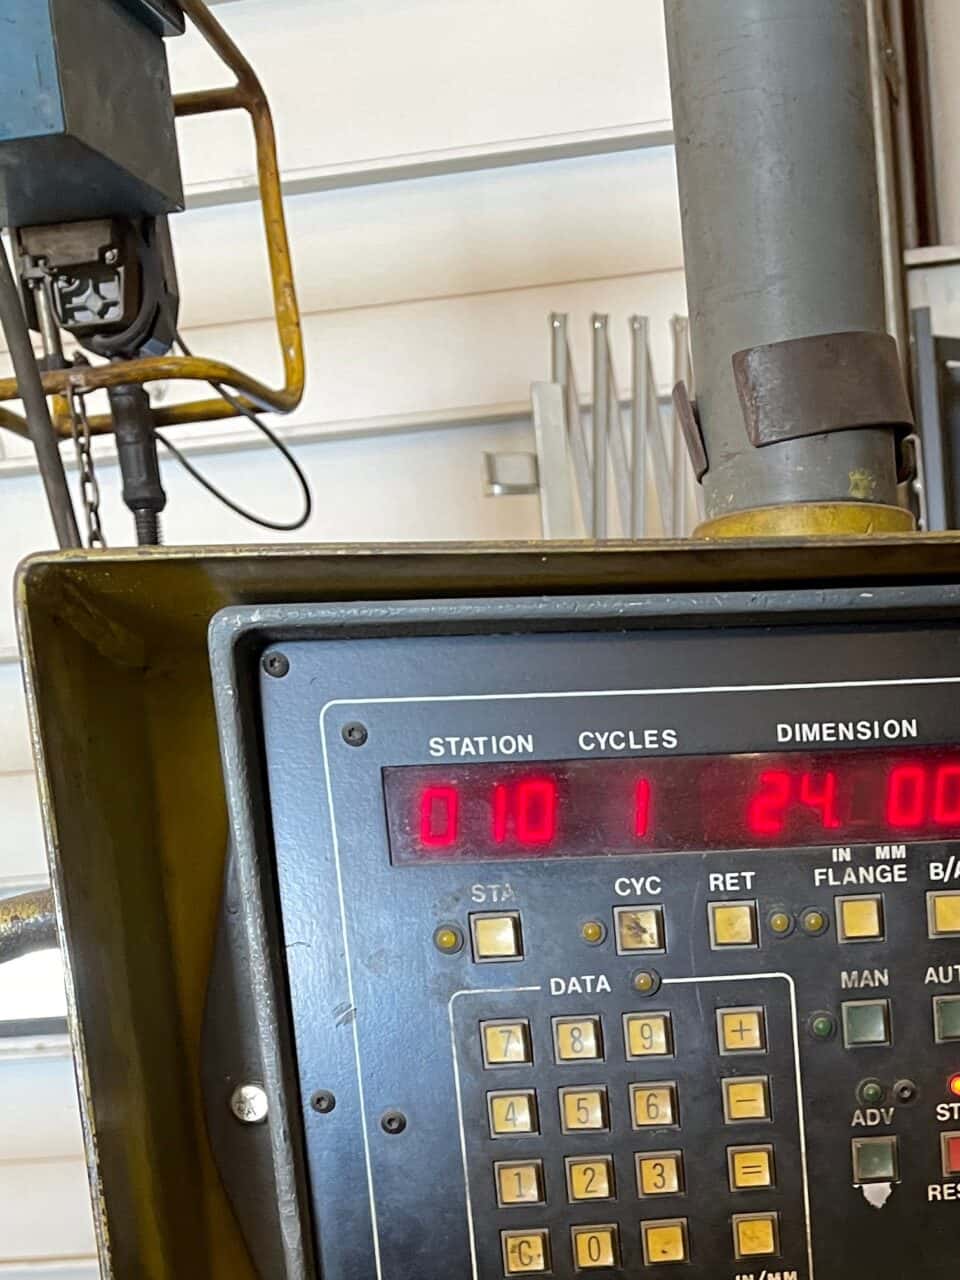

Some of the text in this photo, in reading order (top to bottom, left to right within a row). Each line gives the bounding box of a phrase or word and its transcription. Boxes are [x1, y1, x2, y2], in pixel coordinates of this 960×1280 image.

[578, 729, 678, 752] CYCLES
[776, 719, 919, 743] DIMENSION
[429, 734, 534, 757] STATION
[832, 845, 906, 862] IN MM
[614, 876, 662, 896] CYC
[709, 872, 755, 891] RET
[814, 864, 908, 887] FLANGE
[471, 883, 516, 903] STA
[550, 975, 611, 996] DATA
[841, 969, 889, 989] MAN
[498, 1029, 514, 1057] 7
[571, 1027, 584, 1053] 8
[640, 1023, 653, 1049] 9
[504, 1101, 518, 1125] 4
[576, 1097, 590, 1123] 5
[646, 1093, 659, 1119] 6
[851, 1108, 895, 1127] ADV
[514, 1172, 527, 1197] 1
[583, 1168, 597, 1193] 2
[652, 1163, 666, 1189] 3
[588, 1238, 600, 1263] 0
